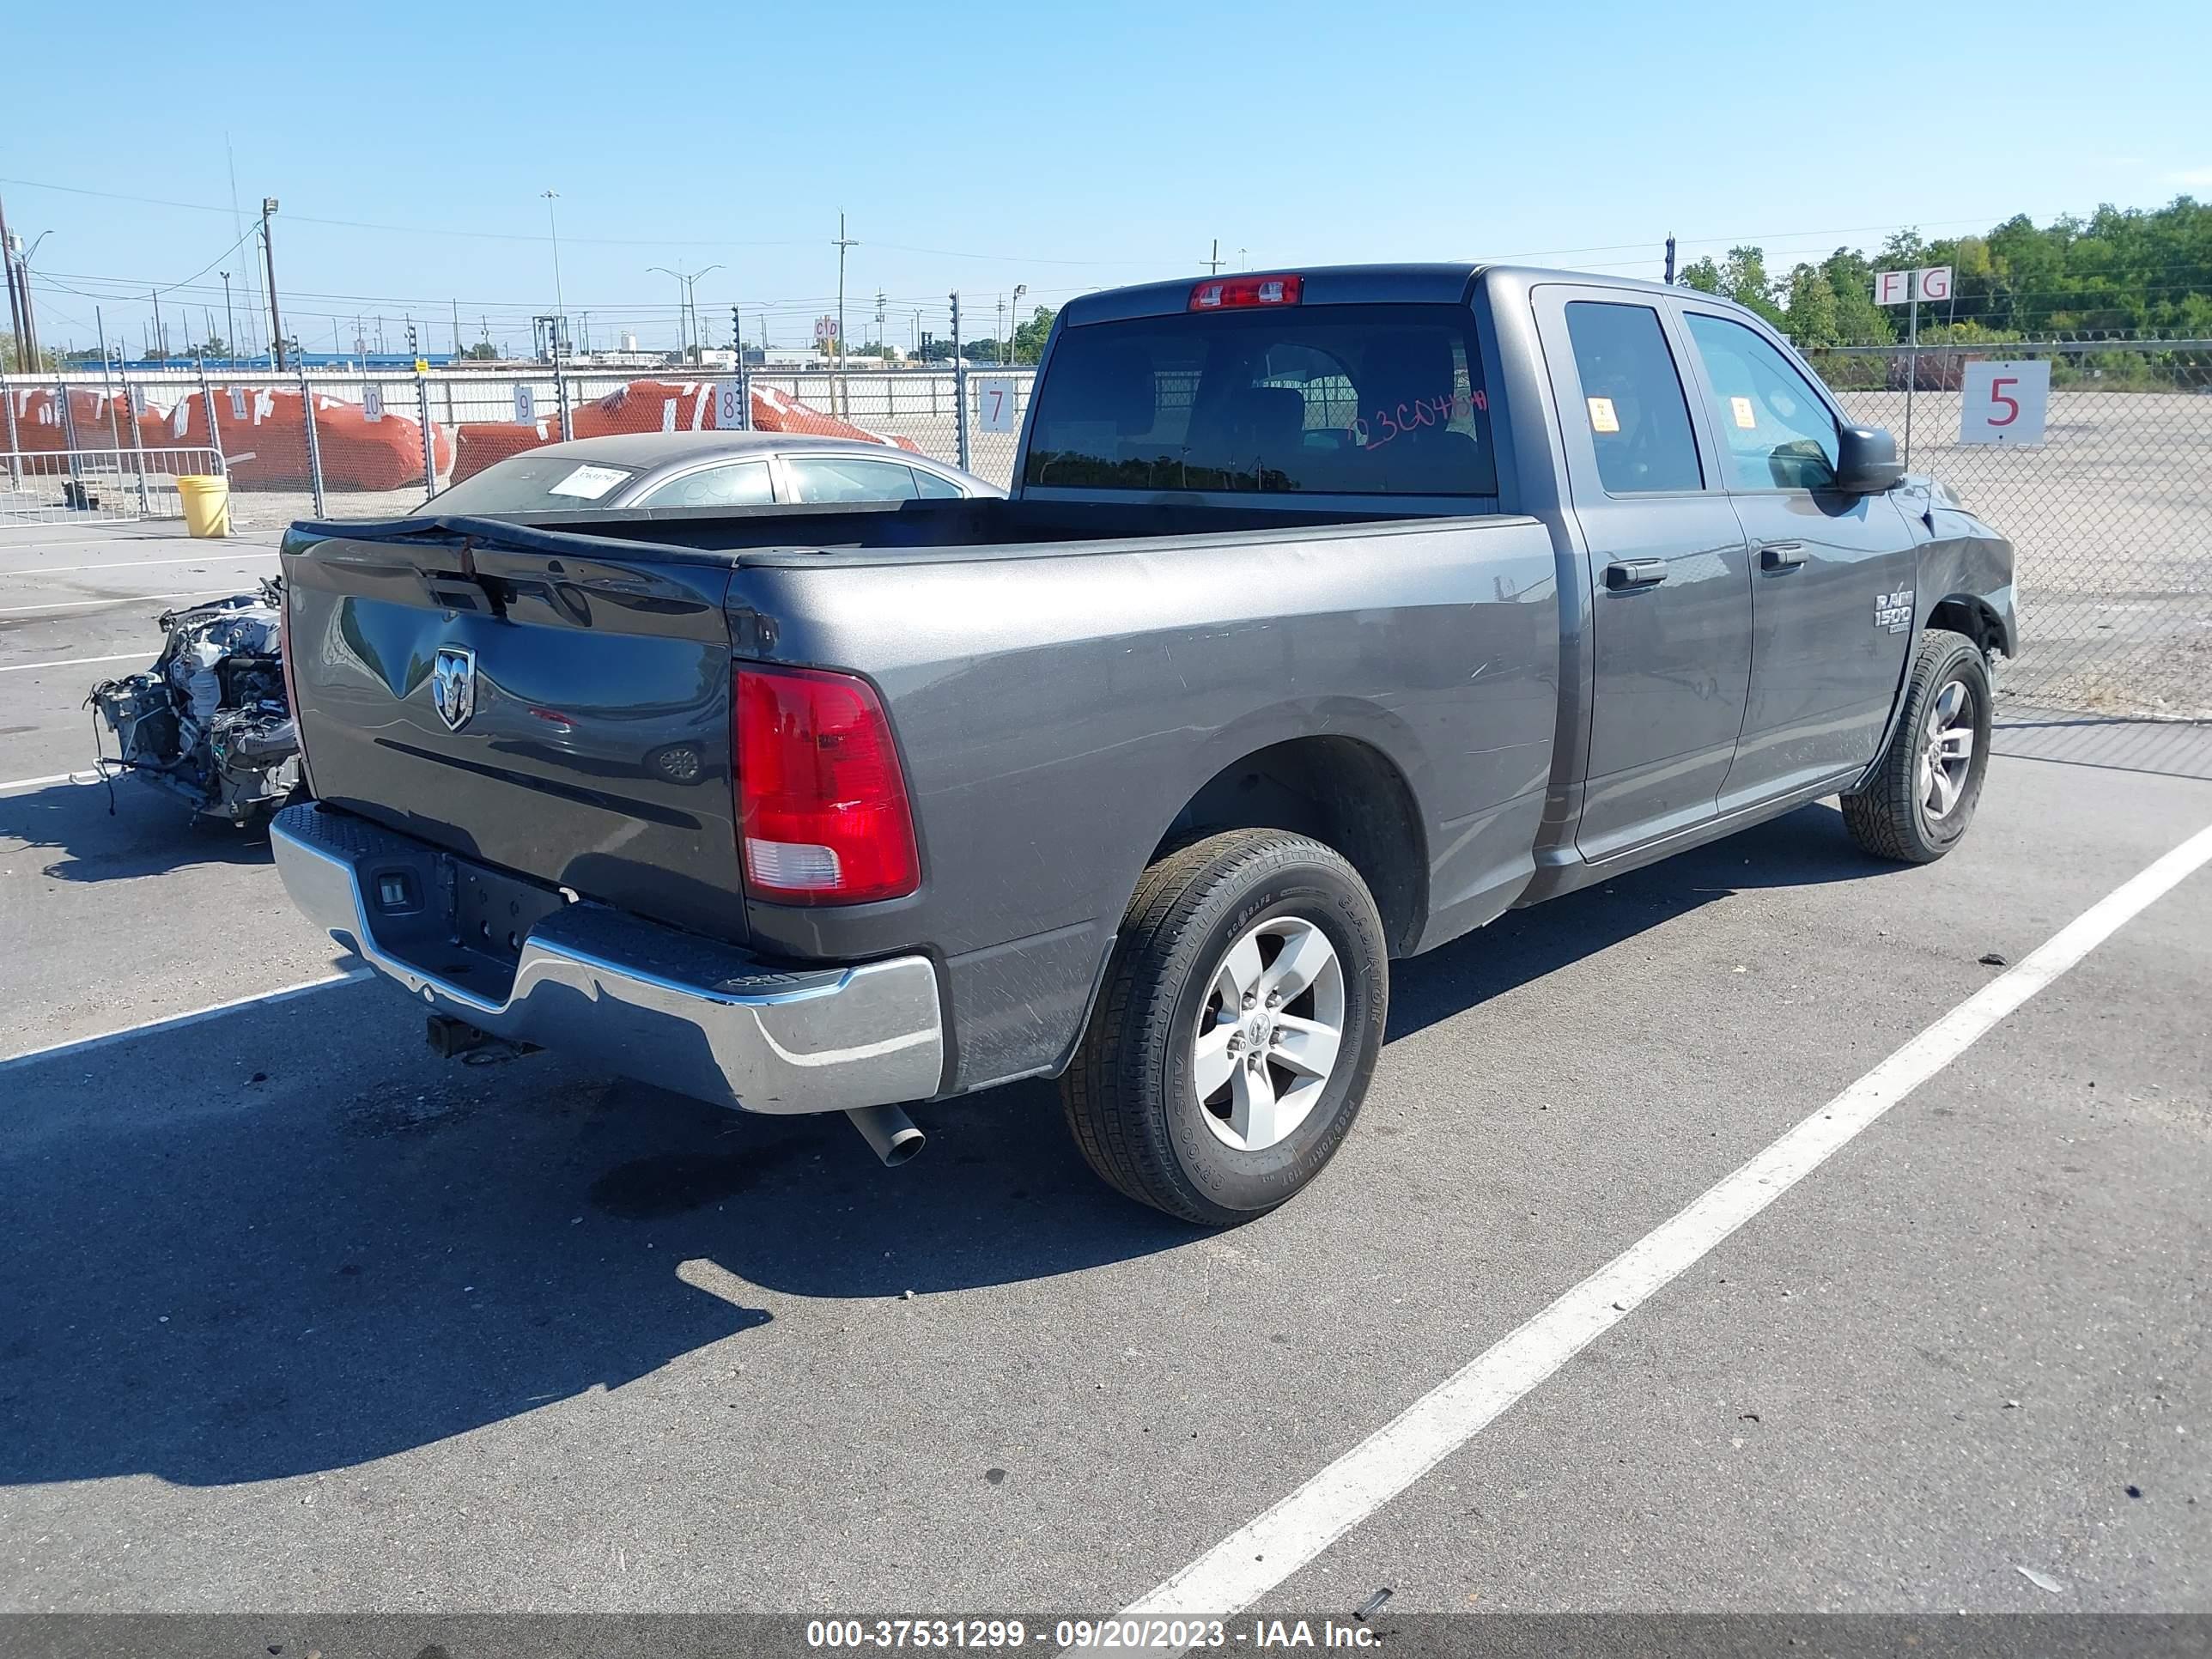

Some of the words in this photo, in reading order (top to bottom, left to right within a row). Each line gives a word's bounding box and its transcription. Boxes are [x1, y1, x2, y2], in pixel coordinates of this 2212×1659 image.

[1882, 273, 1900, 303] F
[1923, 269, 1947, 299] G
[816, 322, 823, 335] C
[830, 323, 838, 336] D
[232, 393, 246, 413] 11
[362, 392, 380, 415] 10
[520, 394, 529, 418] 9
[724, 392, 734, 419] 8
[989, 391, 1003, 422] 7
[1986, 378, 2020, 427] 5
[1875, 591, 1913, 611] RAM
[1875, 607, 1911, 627] 1500
